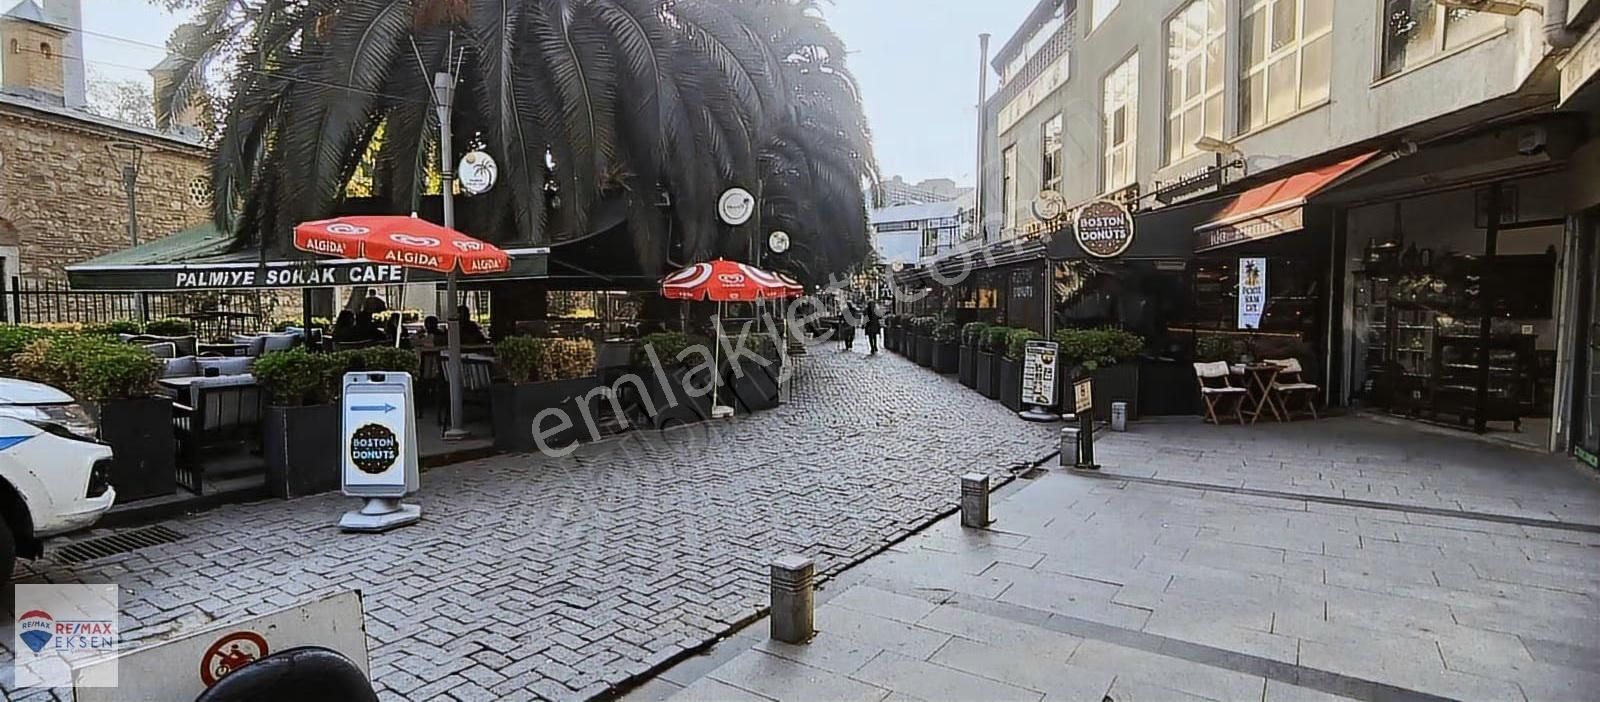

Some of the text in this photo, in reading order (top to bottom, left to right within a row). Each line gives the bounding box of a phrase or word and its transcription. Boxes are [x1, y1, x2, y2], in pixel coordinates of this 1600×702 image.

[1081, 214, 1125, 228] BOSTON
[1081, 228, 1126, 241] DONUTS
[350, 264, 402, 282] CAFE
[353, 436, 394, 448] BOSTON
[353, 450, 395, 460] DONUTS
